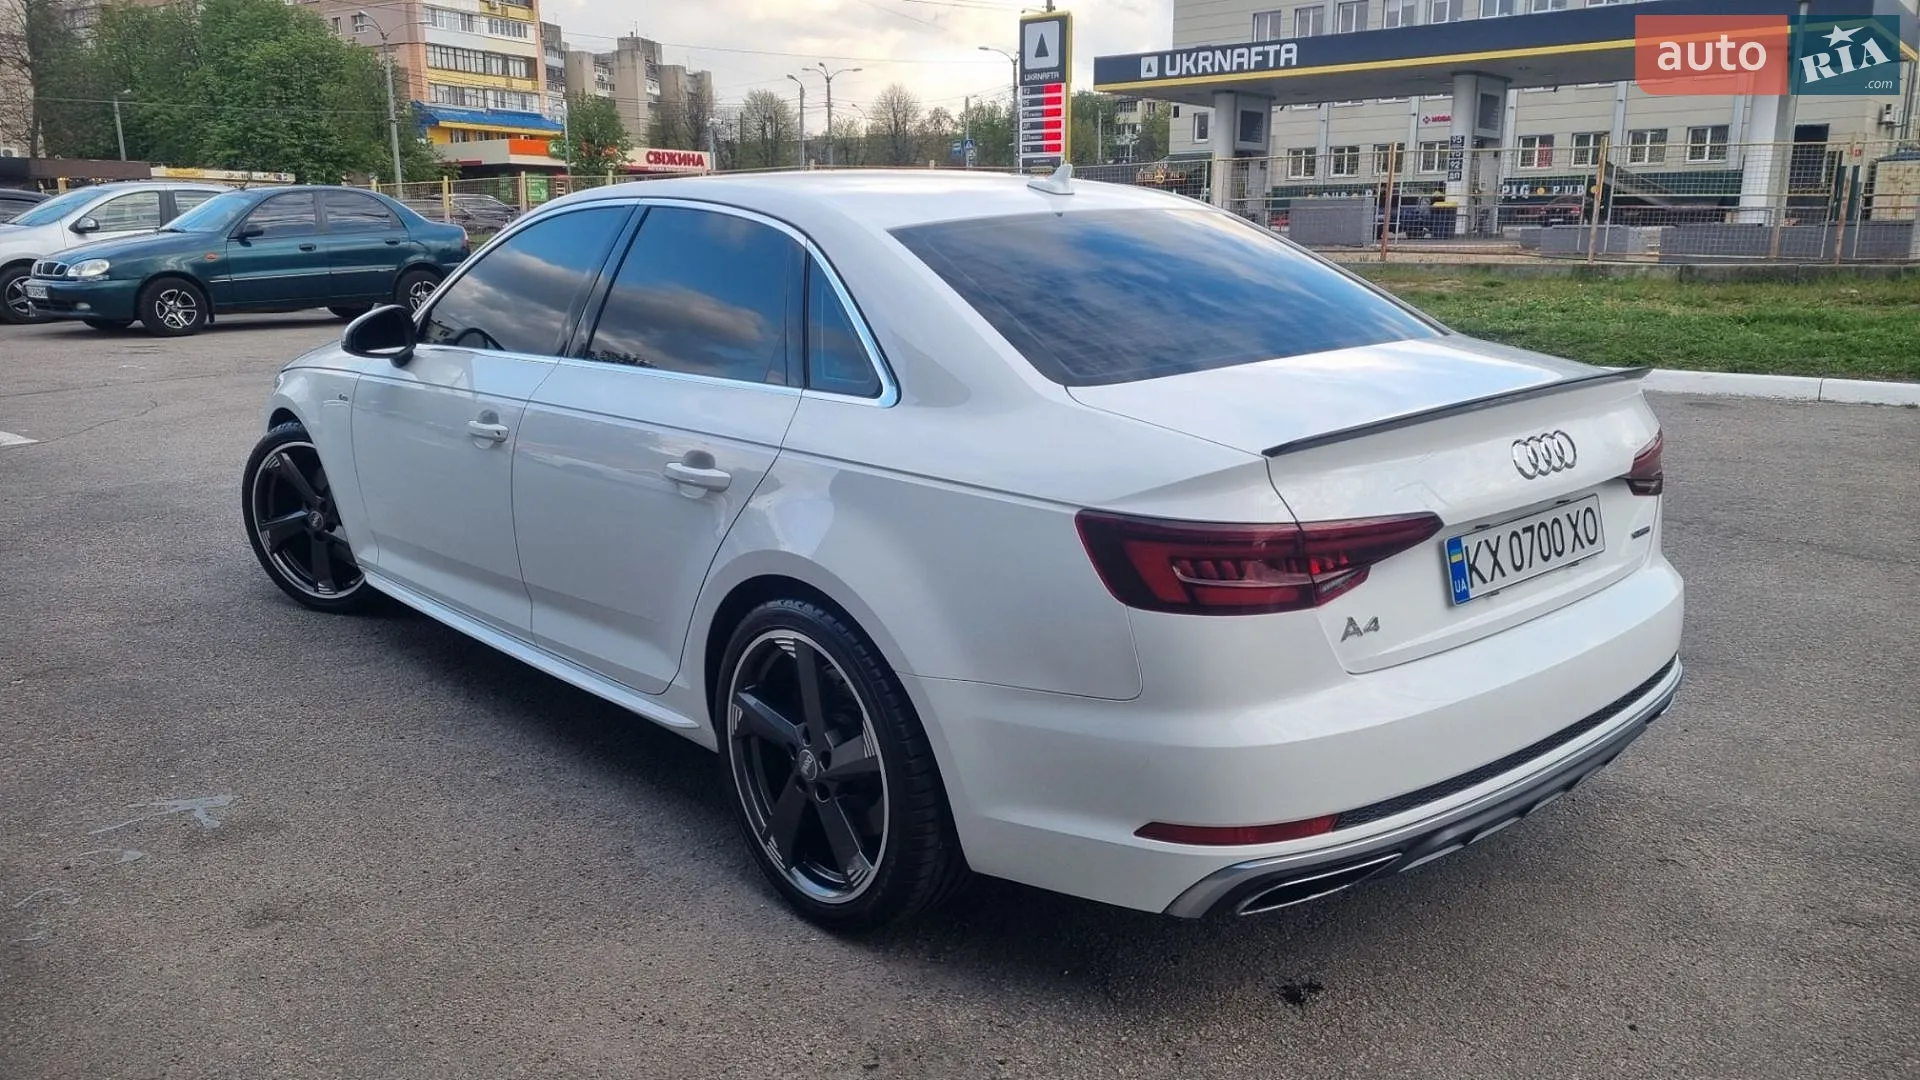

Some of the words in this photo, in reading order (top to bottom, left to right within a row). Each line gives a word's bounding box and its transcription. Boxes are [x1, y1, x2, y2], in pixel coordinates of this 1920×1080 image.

[1165, 43, 1298, 76] UKRNAFTA
[1024, 71, 1060, 81] UKRNAFTA
[646, 151, 704, 167] СВІЖИНА
[1502, 185, 1530, 199] PIG
[1553, 185, 1584, 196] PUB
[1465, 535, 1507, 588] KX
[1509, 517, 1565, 572] 0700
[1566, 507, 1597, 553] XO
[1454, 579, 1467, 593] UA
[1341, 616, 1380, 642] A4
